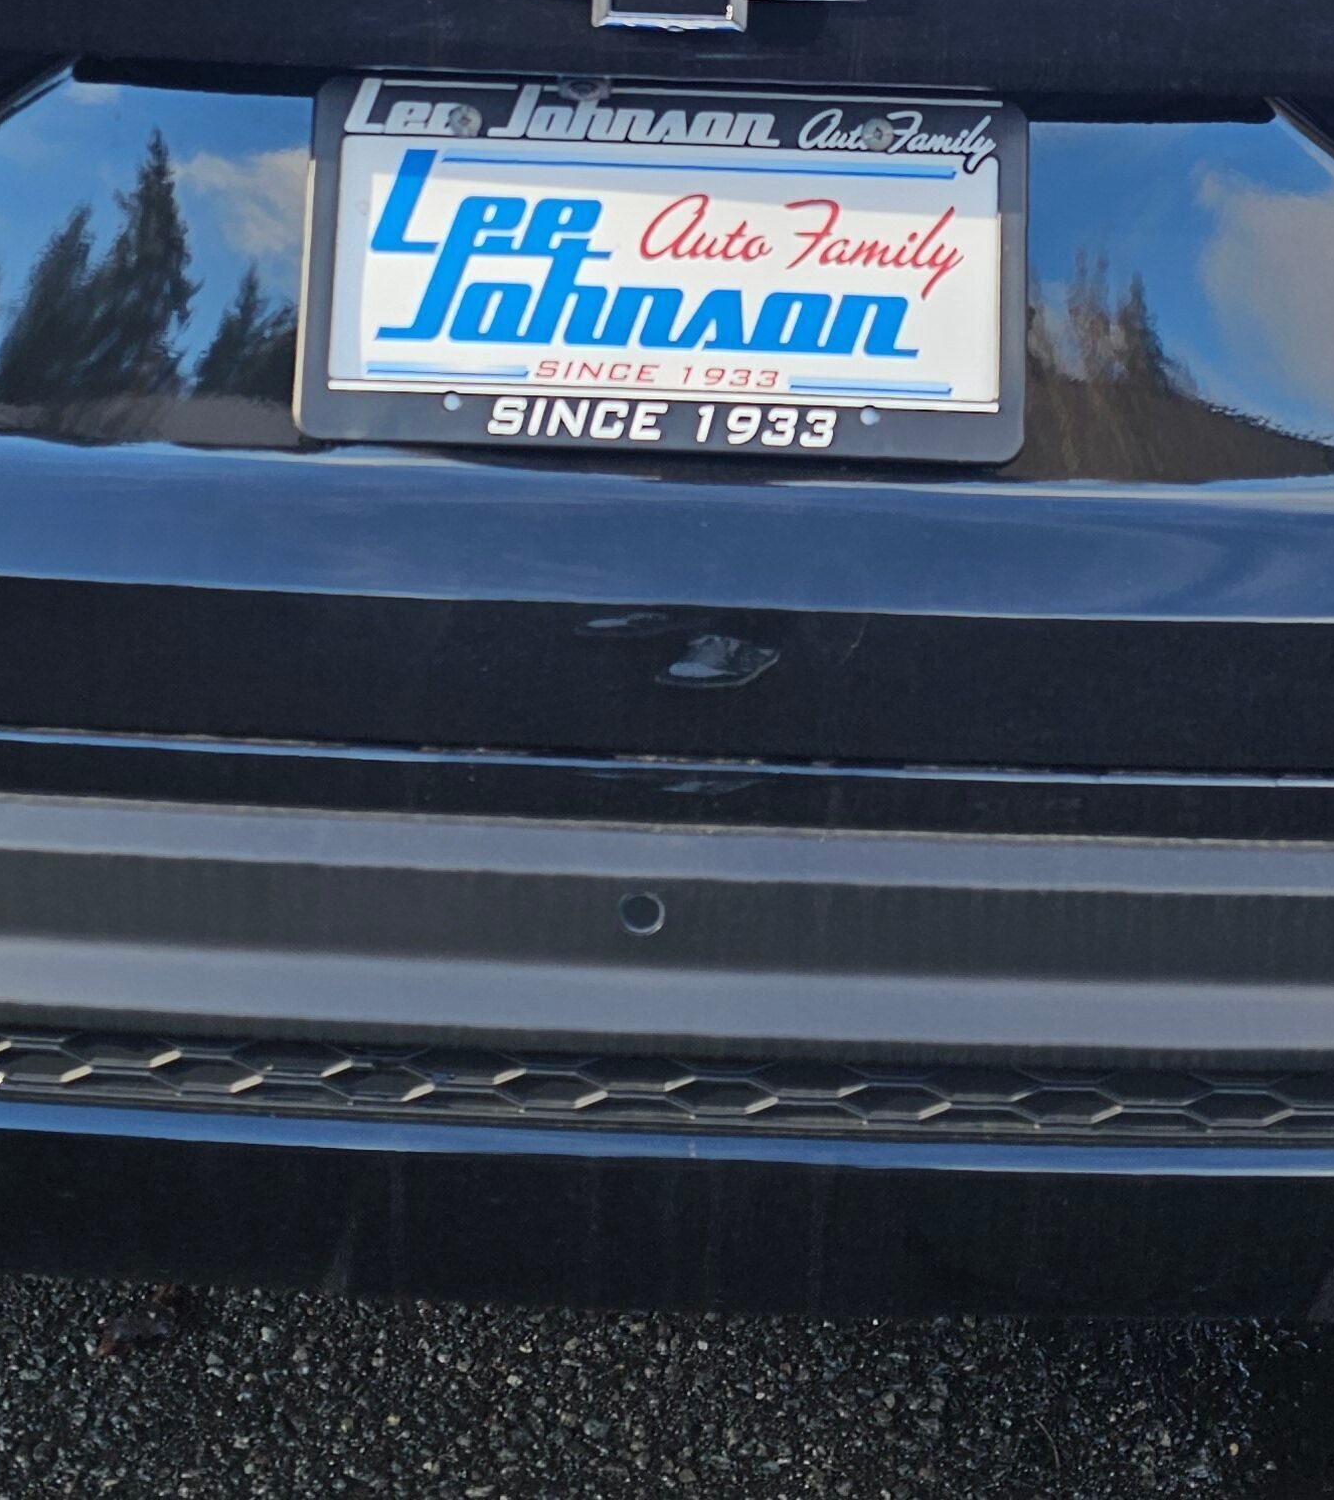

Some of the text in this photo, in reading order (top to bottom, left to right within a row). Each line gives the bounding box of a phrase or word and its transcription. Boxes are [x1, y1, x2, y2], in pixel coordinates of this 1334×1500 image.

[486, 83, 781, 148] Johnson
[797, 108, 889, 152] Aut
[880, 110, 997, 173] Family
[370, 148, 612, 256] Lee
[639, 193, 964, 300] Auto Family
[375, 250, 919, 359] Johnson
[486, 395, 838, 449] SINCE 1933
[535, 359, 780, 389] SINCE 1933
